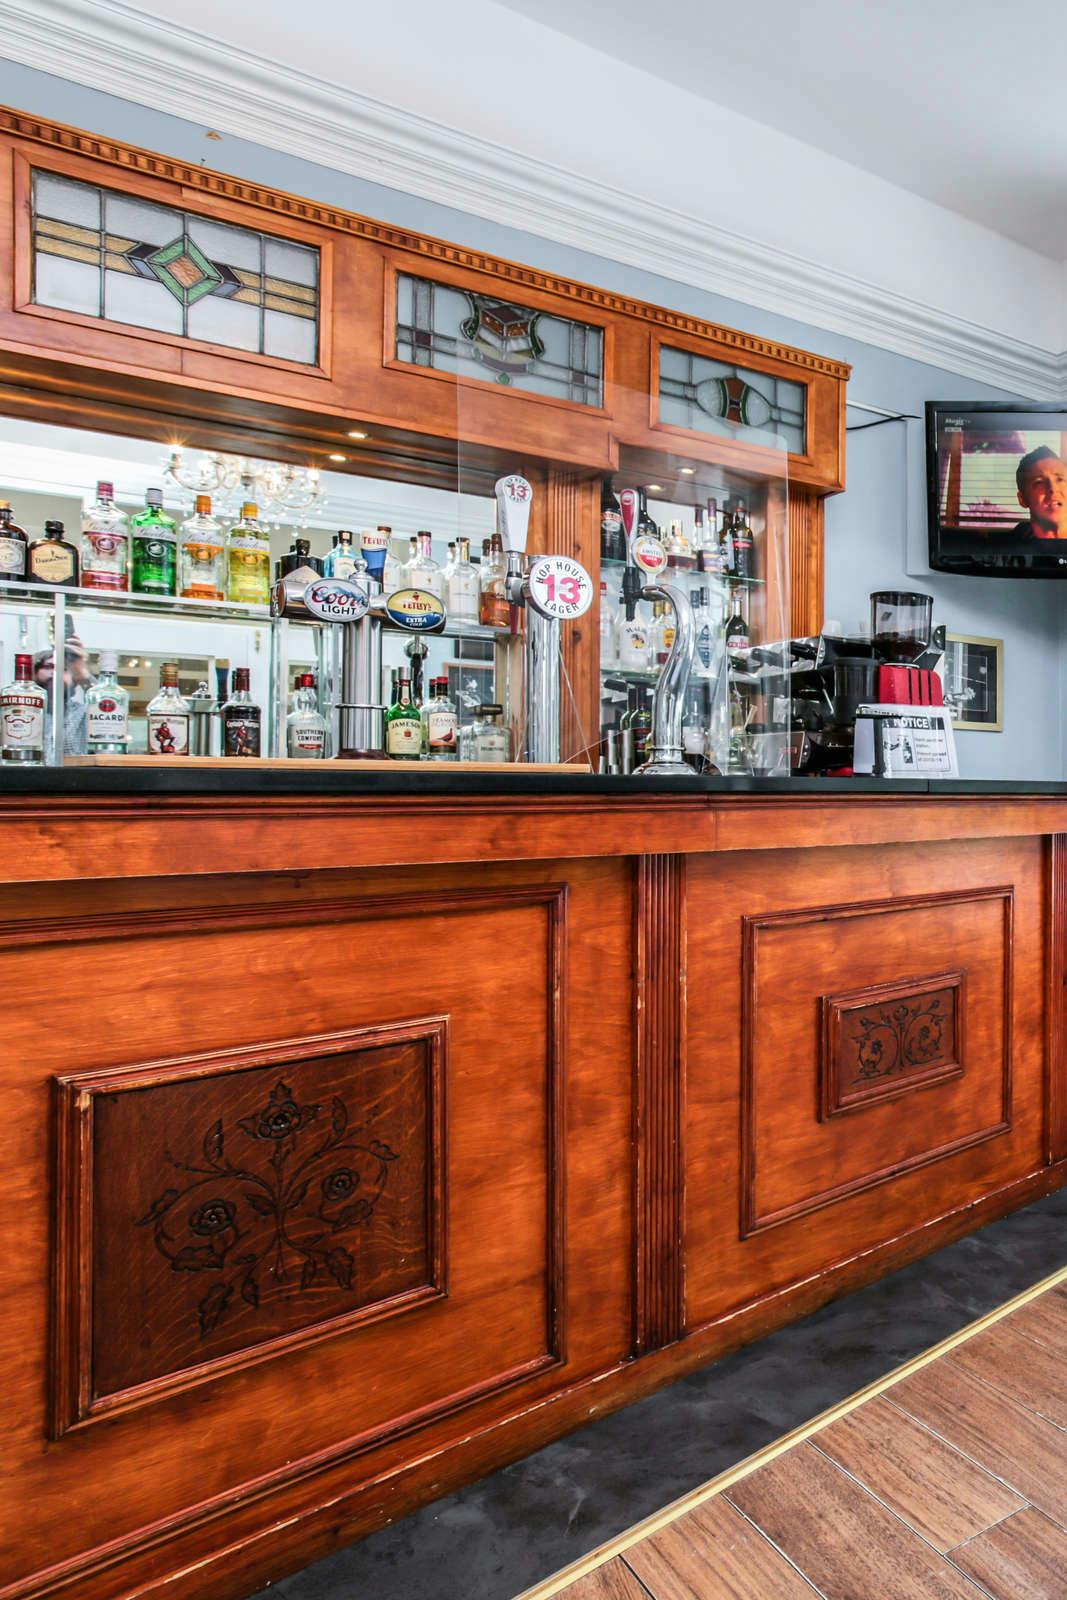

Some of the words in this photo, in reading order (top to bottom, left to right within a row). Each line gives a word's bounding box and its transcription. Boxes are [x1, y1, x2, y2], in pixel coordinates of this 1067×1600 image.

[507, 483, 526, 498] 13
[535, 563, 551, 585] HOP
[556, 561, 587, 590] HOUSE
[543, 574, 581, 605] 13
[321, 604, 357, 616] LIGHT
[544, 599, 580, 614] LAGER
[406, 616, 428, 624] EXTRA
[893, 717, 929, 729] NOTICE
